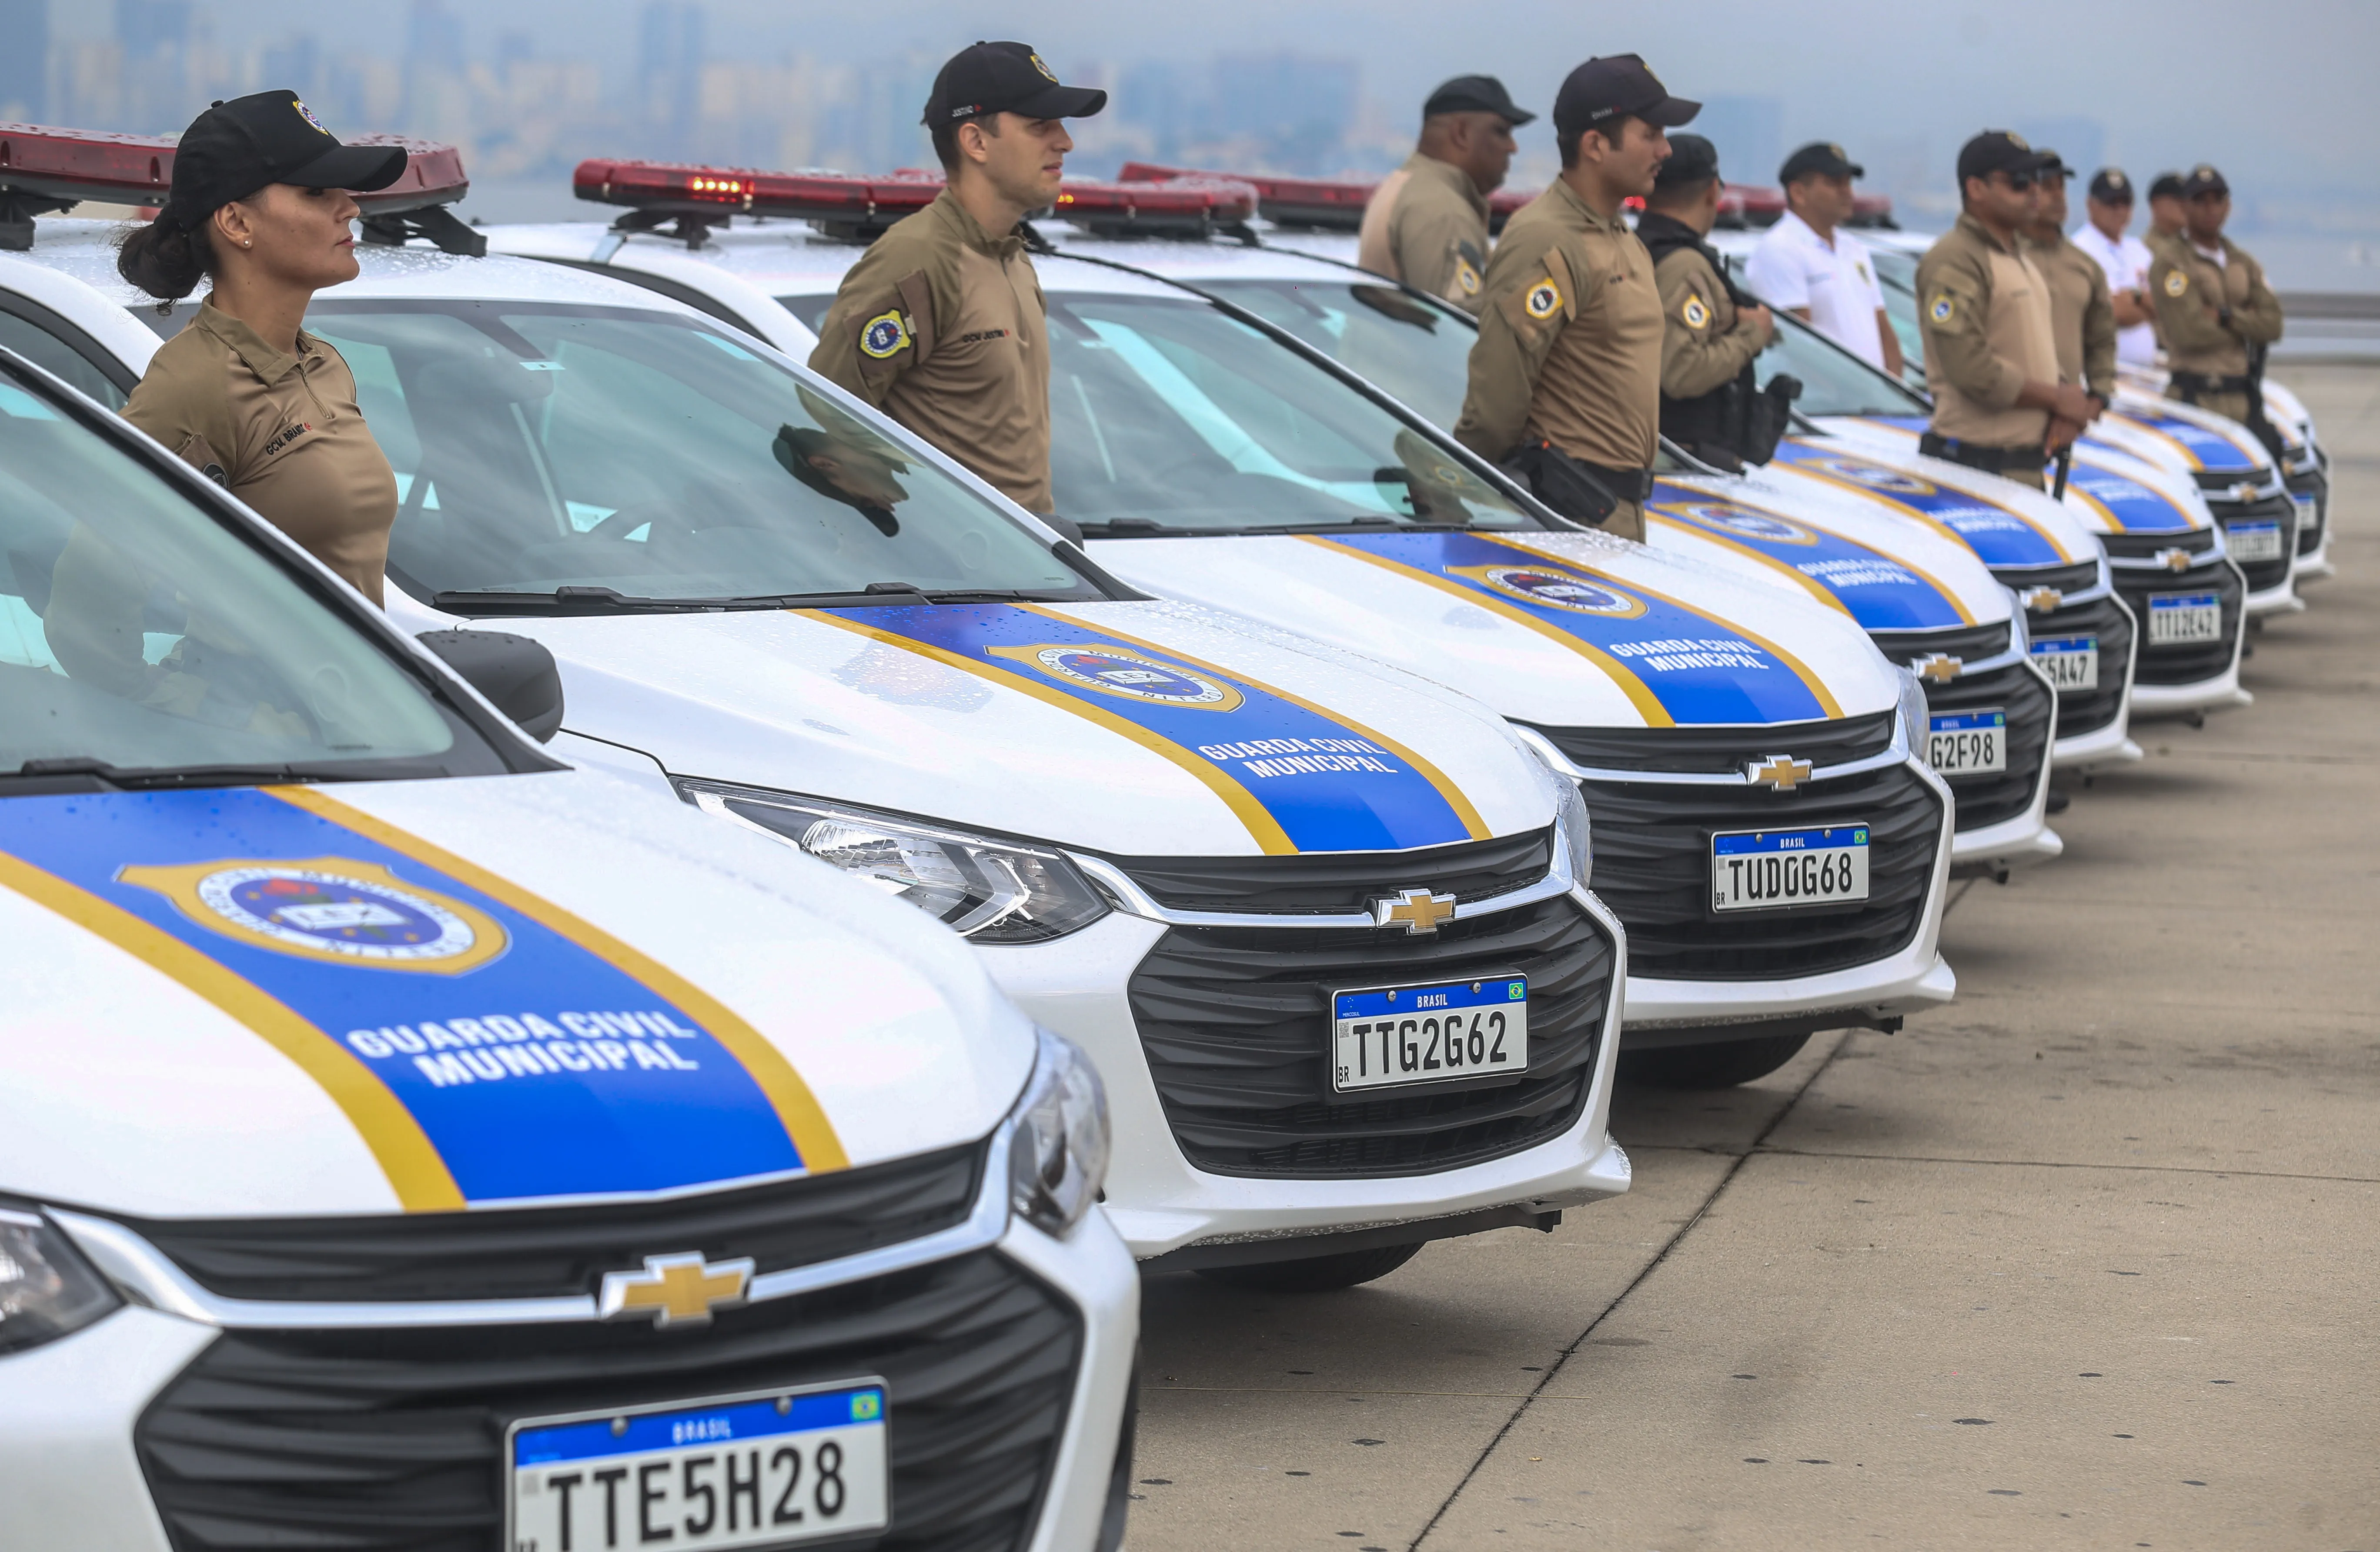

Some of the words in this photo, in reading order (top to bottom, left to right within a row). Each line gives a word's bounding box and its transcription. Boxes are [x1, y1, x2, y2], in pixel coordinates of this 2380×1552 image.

[1609, 639, 1707, 657] GUARDA
[1699, 639, 1762, 654] CIVIL
[1644, 652, 1769, 672] MUNICIPAL
[1198, 738, 1319, 761] GUARDA
[1308, 738, 1388, 755] CIVIL
[1242, 755, 1398, 778] MUNICIPAL
[1780, 837, 1805, 849] BRASIL
[1716, 892, 1725, 905] BR
[1417, 993, 1448, 1008] BRASIL
[347, 1012, 567, 1058] GUARDA
[557, 1010, 697, 1038] CIVIL
[1353, 1010, 1507, 1077] TTG2G62
[412, 1040, 700, 1087] MUNICIPAL
[1338, 1066, 1350, 1083] BR
[672, 1417, 732, 1444] BRASIL
[548, 1442, 846, 1552] TTE5H28
